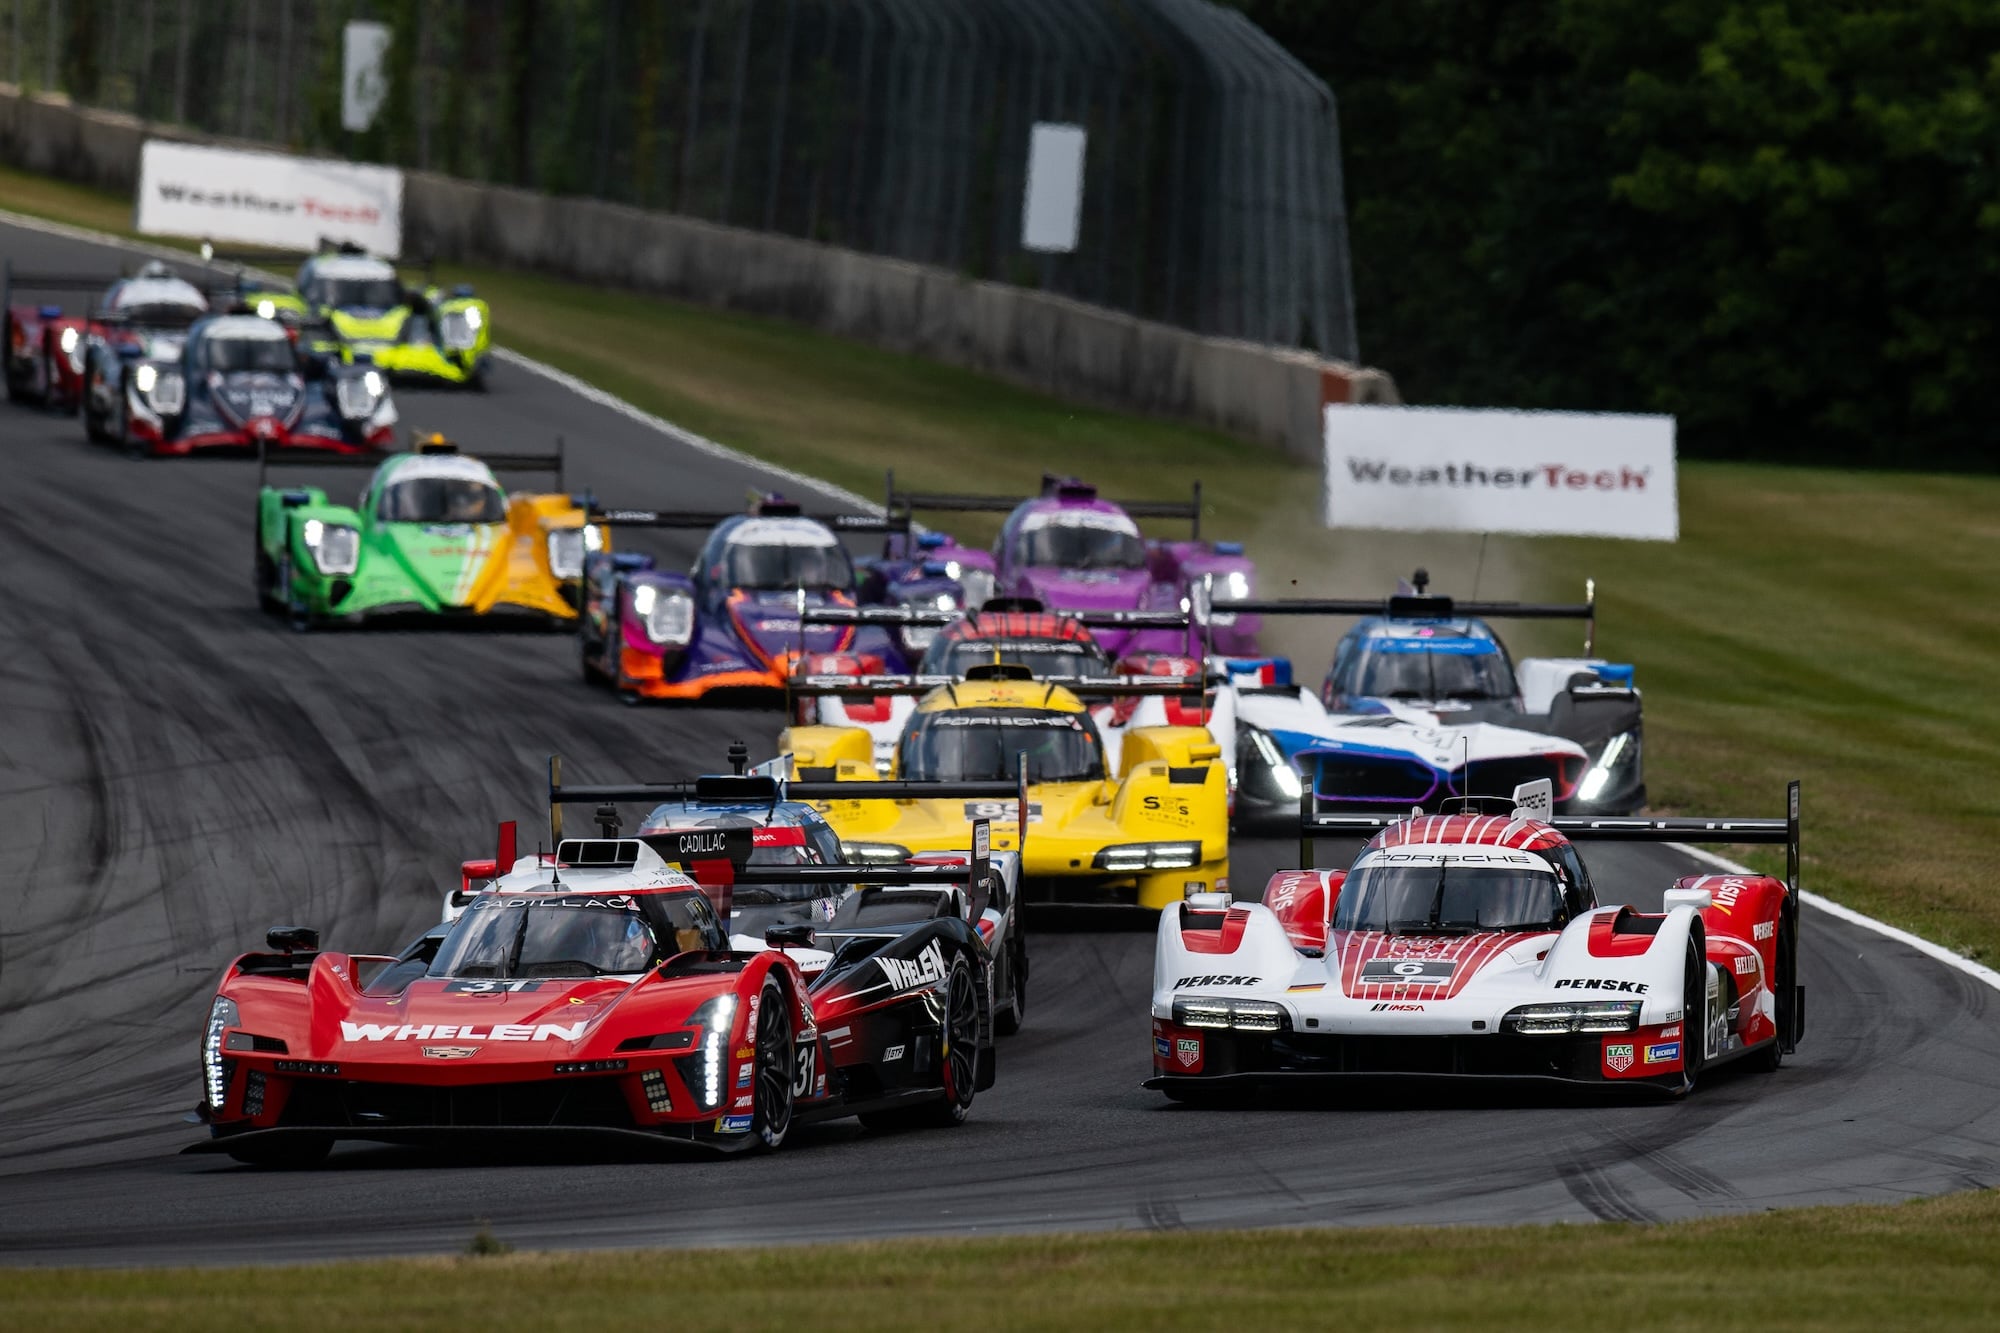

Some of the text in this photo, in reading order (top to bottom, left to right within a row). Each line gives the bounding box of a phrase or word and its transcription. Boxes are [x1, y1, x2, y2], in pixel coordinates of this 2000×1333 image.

[1348, 456, 1648, 491] WeatherTech
[934, 716, 1072, 727] PORSCHE
[679, 832, 726, 854] CADILLAC
[1373, 854, 1532, 864] PORSCHE
[1272, 873, 1313, 911] Ansys
[473, 898, 632, 910] CADILLAC
[1753, 920, 1774, 941] PENSKE
[872, 936, 947, 992] WHELEN
[1393, 962, 1425, 975] 6
[460, 980, 530, 993] 31
[1172, 975, 1263, 990] PENSKE
[1554, 979, 1649, 995] PENSKE
[1388, 1004, 1425, 1012] IMSA
[340, 1020, 590, 1042] WHELEN
[1660, 1026, 1680, 1038] MOTUL
[1179, 1042, 1198, 1051] TAG
[1608, 1047, 1633, 1056] TAG
[1655, 1048, 1677, 1058] MICHELIN
[1179, 1052, 1199, 1066] HEUER
[1608, 1056, 1633, 1069] HEUER
[793, 1046, 816, 1098] 31
